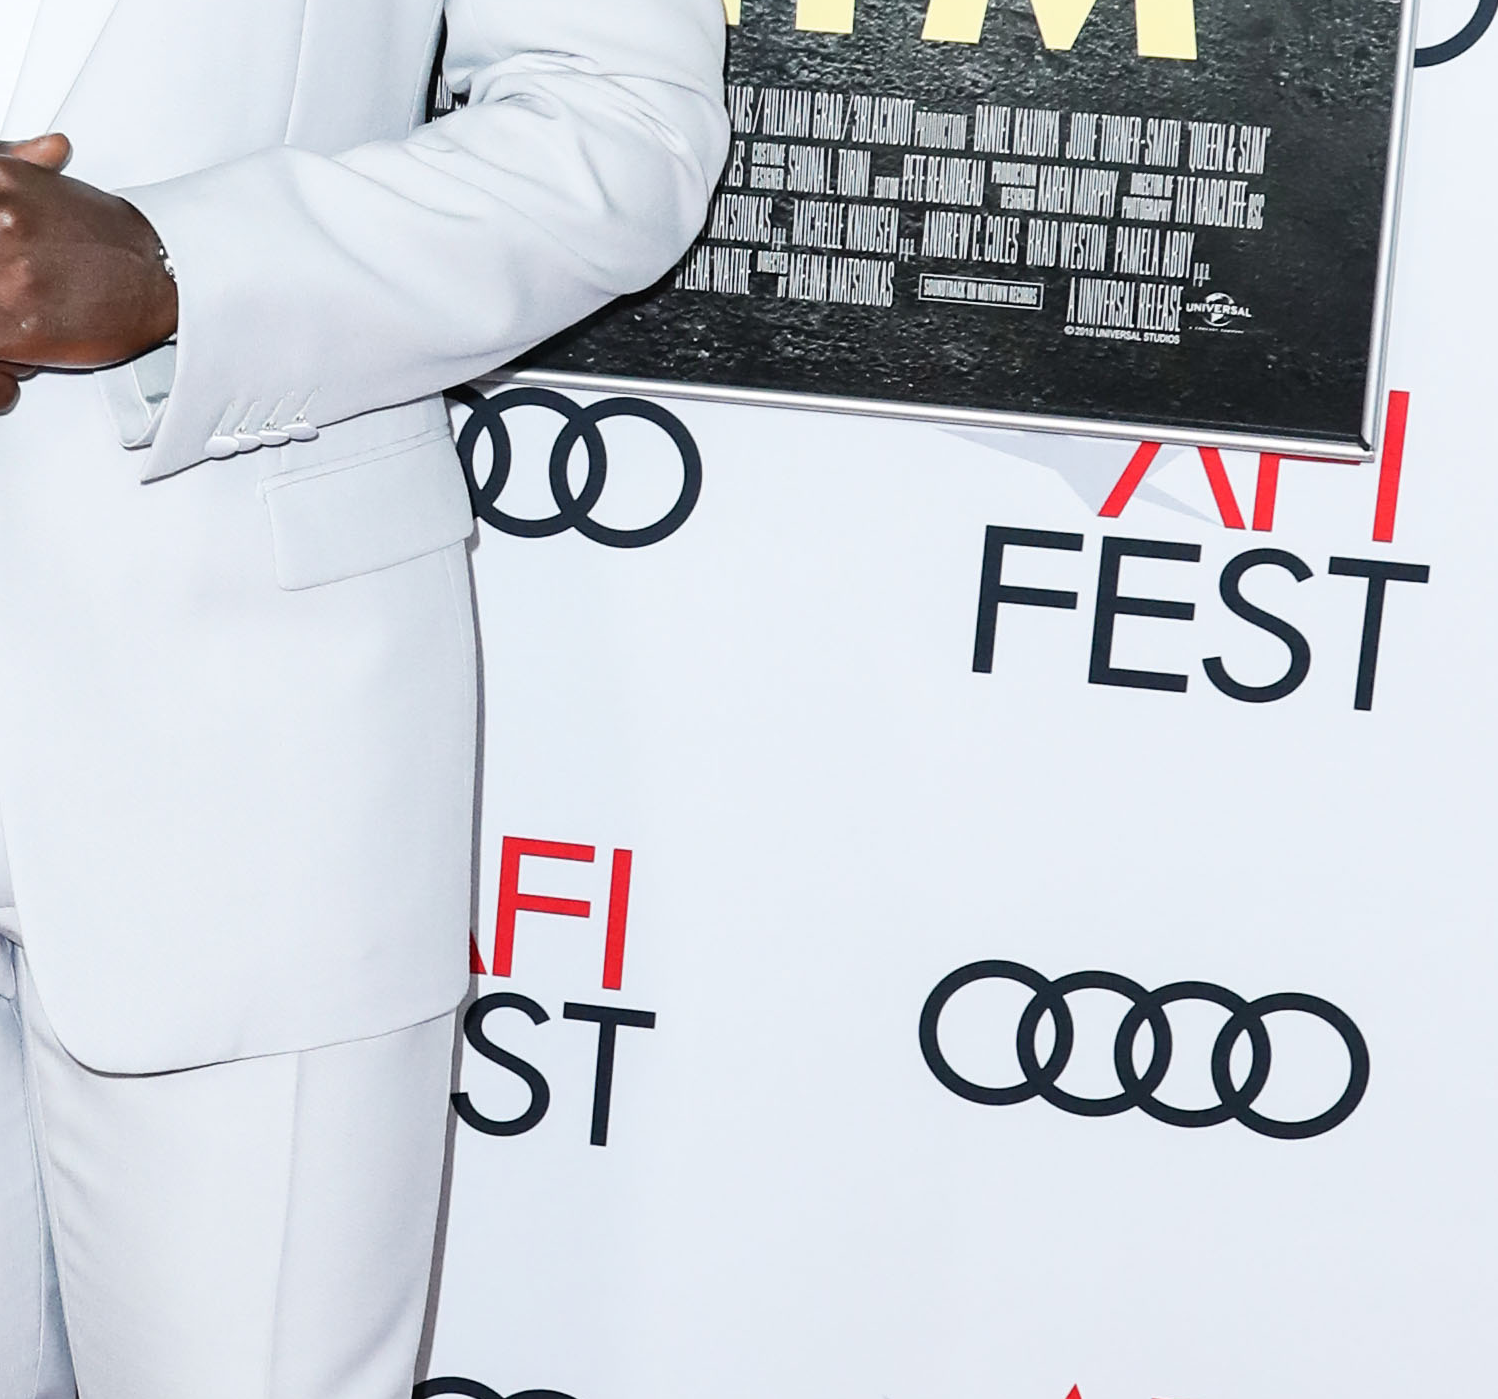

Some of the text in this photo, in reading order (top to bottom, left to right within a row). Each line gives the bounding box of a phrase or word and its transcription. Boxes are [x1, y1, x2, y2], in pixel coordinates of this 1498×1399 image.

[751, 142, 787, 167] COSTUME
[914, 111, 969, 151] PRODUCTION
[974, 104, 1012, 154] DANIEL
[1013, 108, 1060, 158] KALUUYA
[1066, 111, 1100, 161] JODIE
[1099, 114, 1182, 168] TURNER-SMITH
[1225, 124, 1237, 173] &
[749, 165, 785, 190] DESIGNER
[873, 175, 900, 200] EDITOR
[901, 153, 925, 203] PETE
[925, 154, 987, 207] BEAUDREAU
[990, 160, 1039, 187] PRODUCTION
[1037, 164, 1120, 220] KAREN MURPHY
[1130, 172, 1164, 197] DIRECTOR
[1000, 185, 1037, 212] DESIGNER
[1174, 176, 1266, 230] TAT RADCLIFFE BSC
[792, 199, 846, 250] MICHELLE
[845, 203, 900, 254] KNUDSEN
[920, 210, 972, 260] ANDREW
[983, 214, 1020, 265] COLES
[1025, 218, 1058, 269] BRAD
[1059, 221, 1109, 273] WESTON
[1113, 225, 1162, 278] PAMELA
[1162, 229, 1196, 280] ABDY
[713, 246, 753, 295] WAITHE
[756, 249, 789, 275] DIRECTED
[788, 252, 896, 308] MELINA MATSOUKAS
[776, 275, 788, 298] BY
[923, 278, 968, 299] SOUNDTRACK
[1065, 276, 1185, 333] A UNIVERSAL RELEASE
[1185, 303, 1253, 319] UNIVERSAL
[1095, 327, 1143, 342] UNIVERSAL
[1143, 332, 1182, 346] STUDIOS
[972, 525, 1430, 711] FEST
[469, 835, 633, 991] FI
